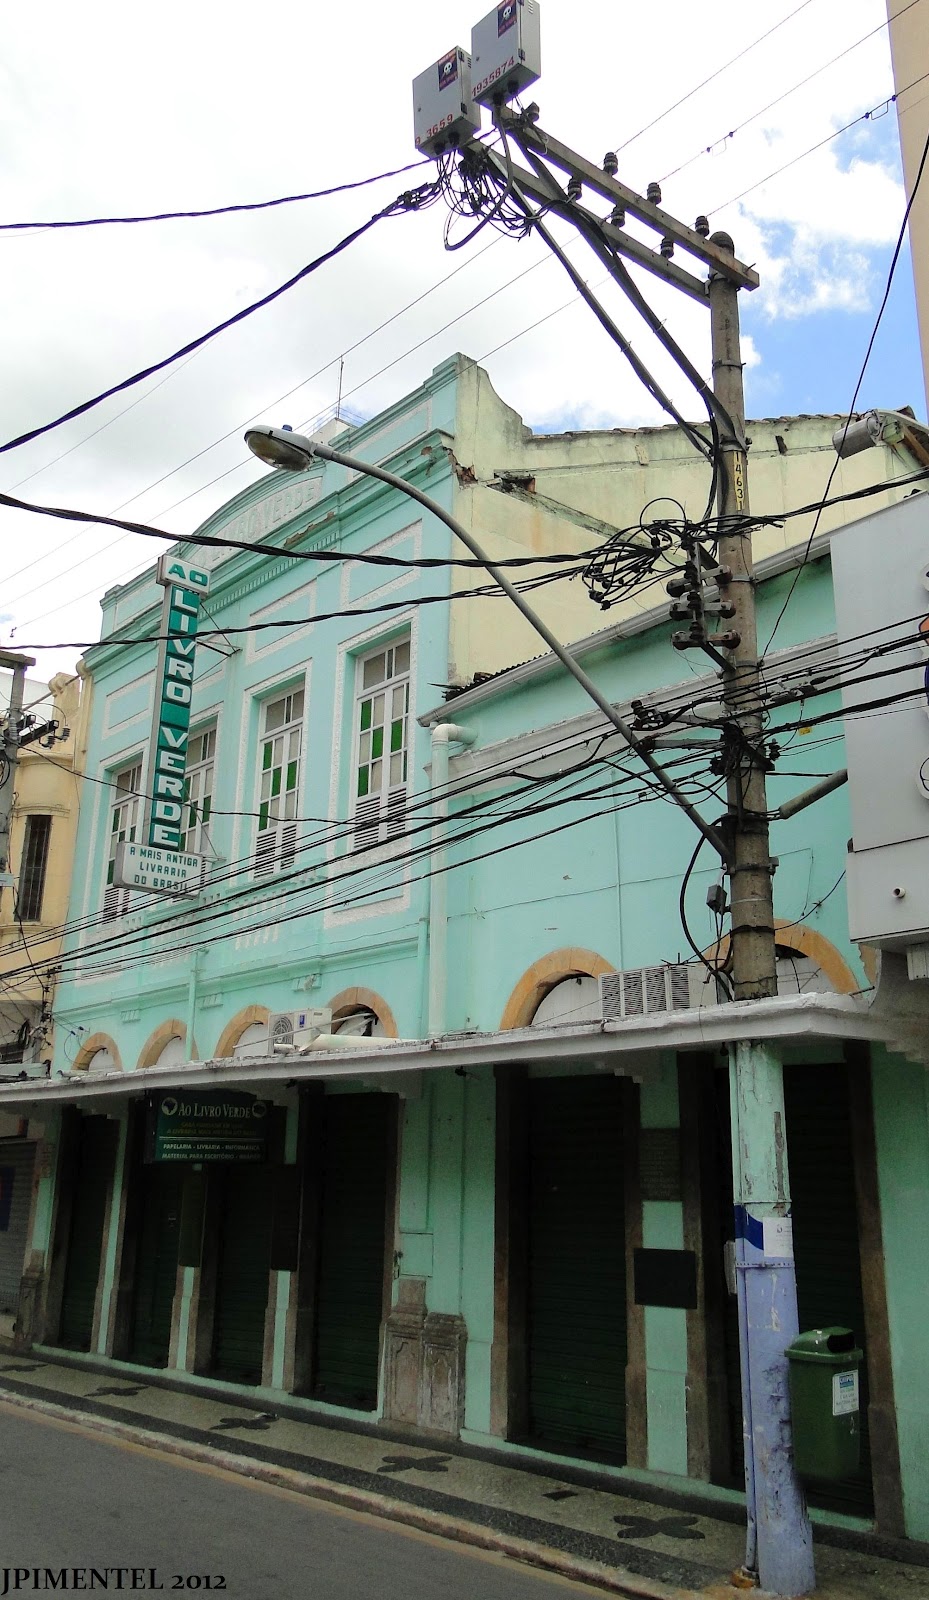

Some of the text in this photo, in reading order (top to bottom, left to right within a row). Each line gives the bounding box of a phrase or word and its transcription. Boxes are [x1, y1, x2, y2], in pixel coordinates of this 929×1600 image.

[471, 56, 515, 97] 1935874
[427, 113, 453, 138] 3659
[168, 563, 208, 587] AO
[166, 589, 198, 704] LIVRO
[153, 727, 188, 847] VERDE
[130, 846, 198, 867] A MAIS ANTIGA
[139, 861, 187, 878] LIVRARIA
[134, 874, 188, 892] DO BRASIL
[193, 1103, 221, 1118] LIVRO
[222, 1103, 251, 1119] VERDE
